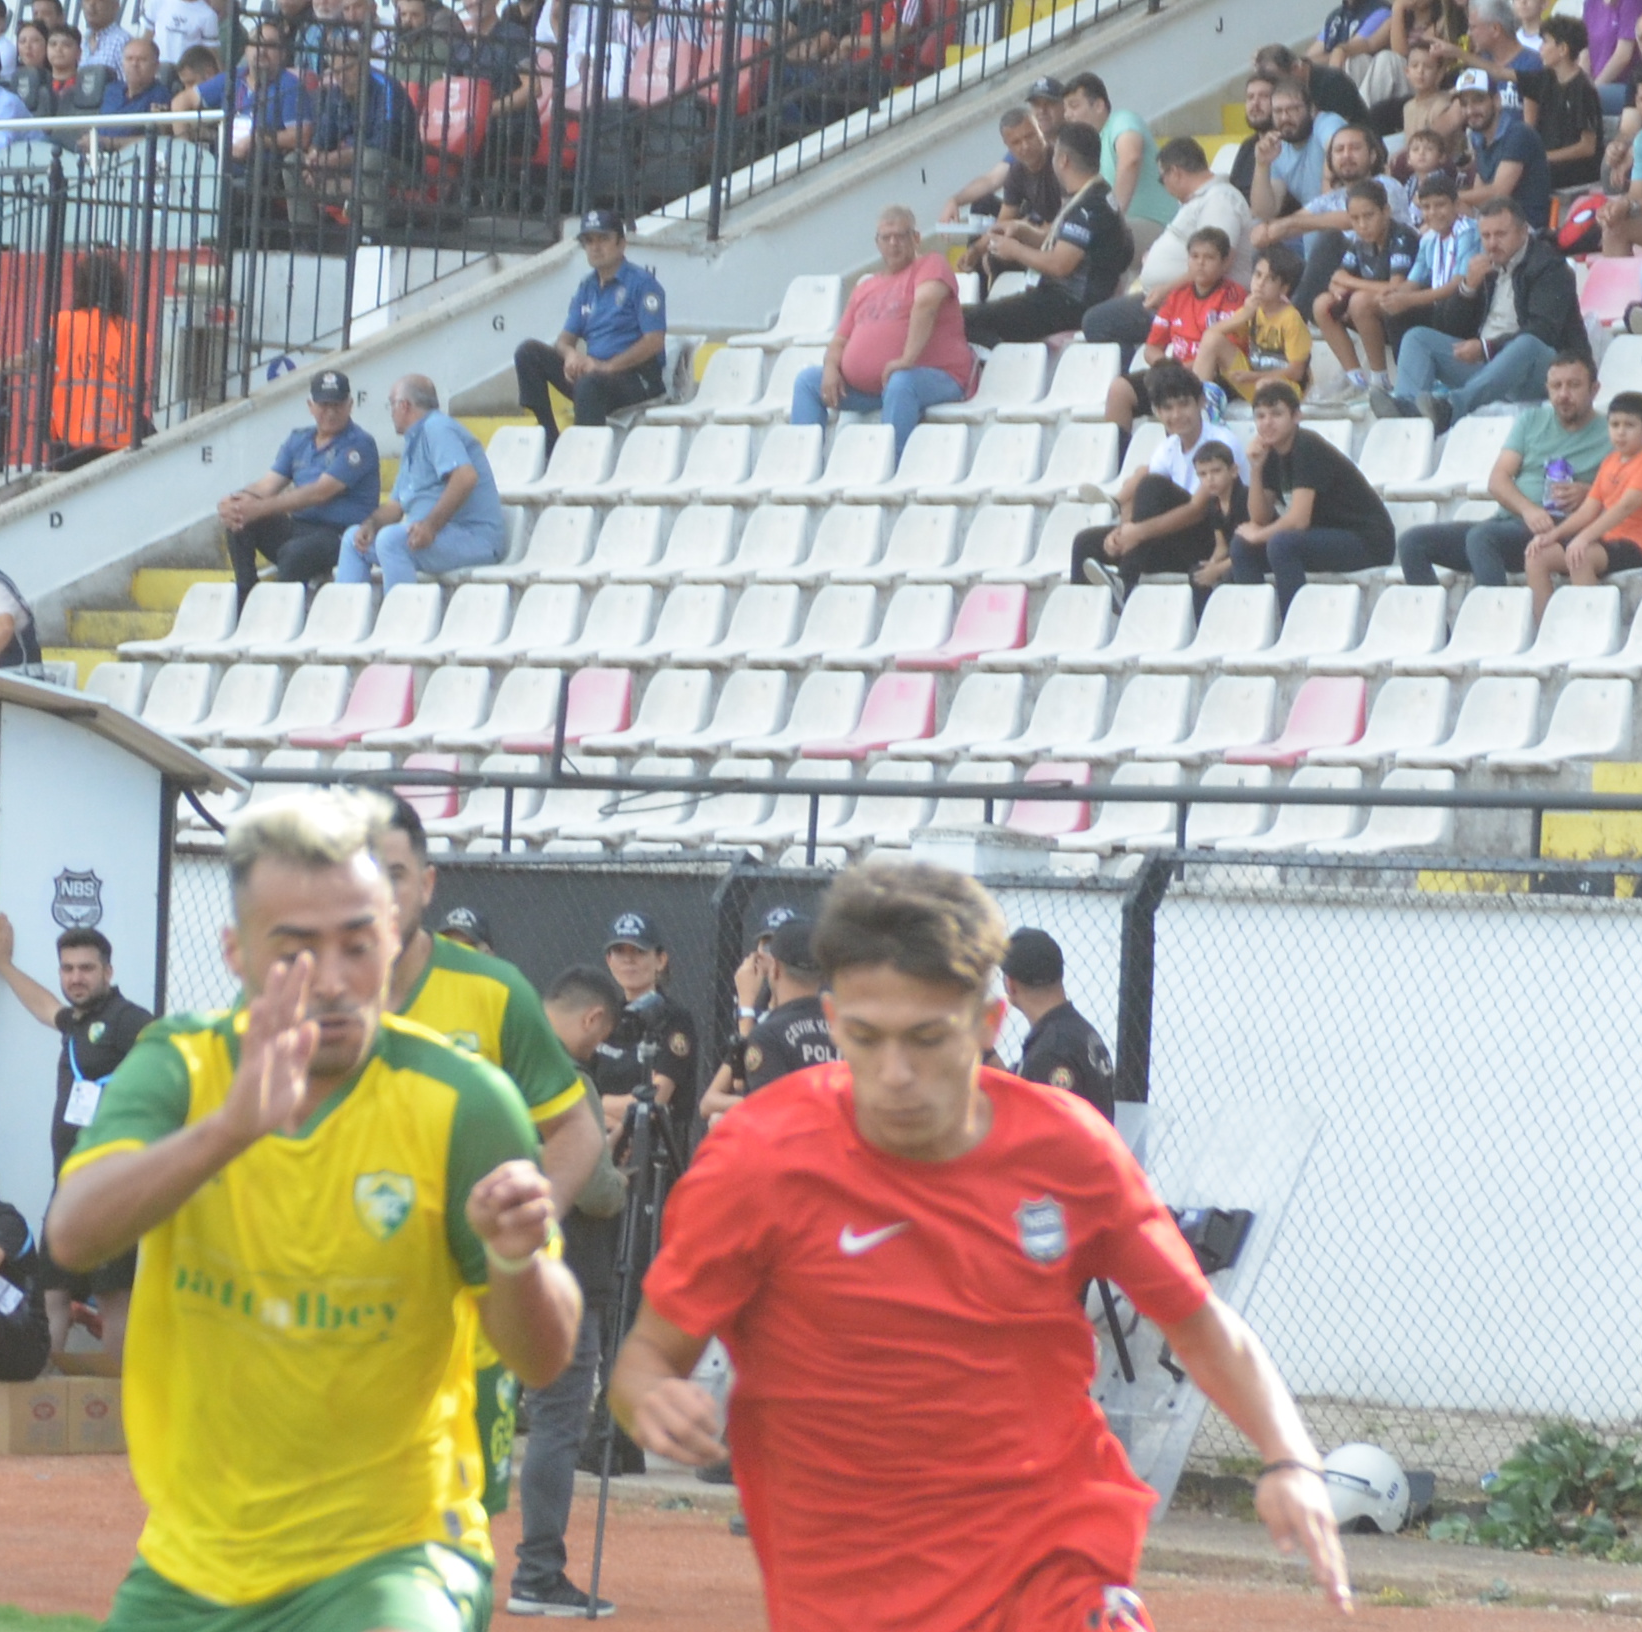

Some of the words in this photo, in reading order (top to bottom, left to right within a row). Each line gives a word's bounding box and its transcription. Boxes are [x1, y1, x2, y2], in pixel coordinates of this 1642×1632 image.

[1215, 17, 1224, 33] J
[492, 315, 505, 331] G
[357, 390, 368, 408] F
[201, 446, 213, 464] E
[49, 511, 63, 529] D
[60, 880, 95, 897] NBS
